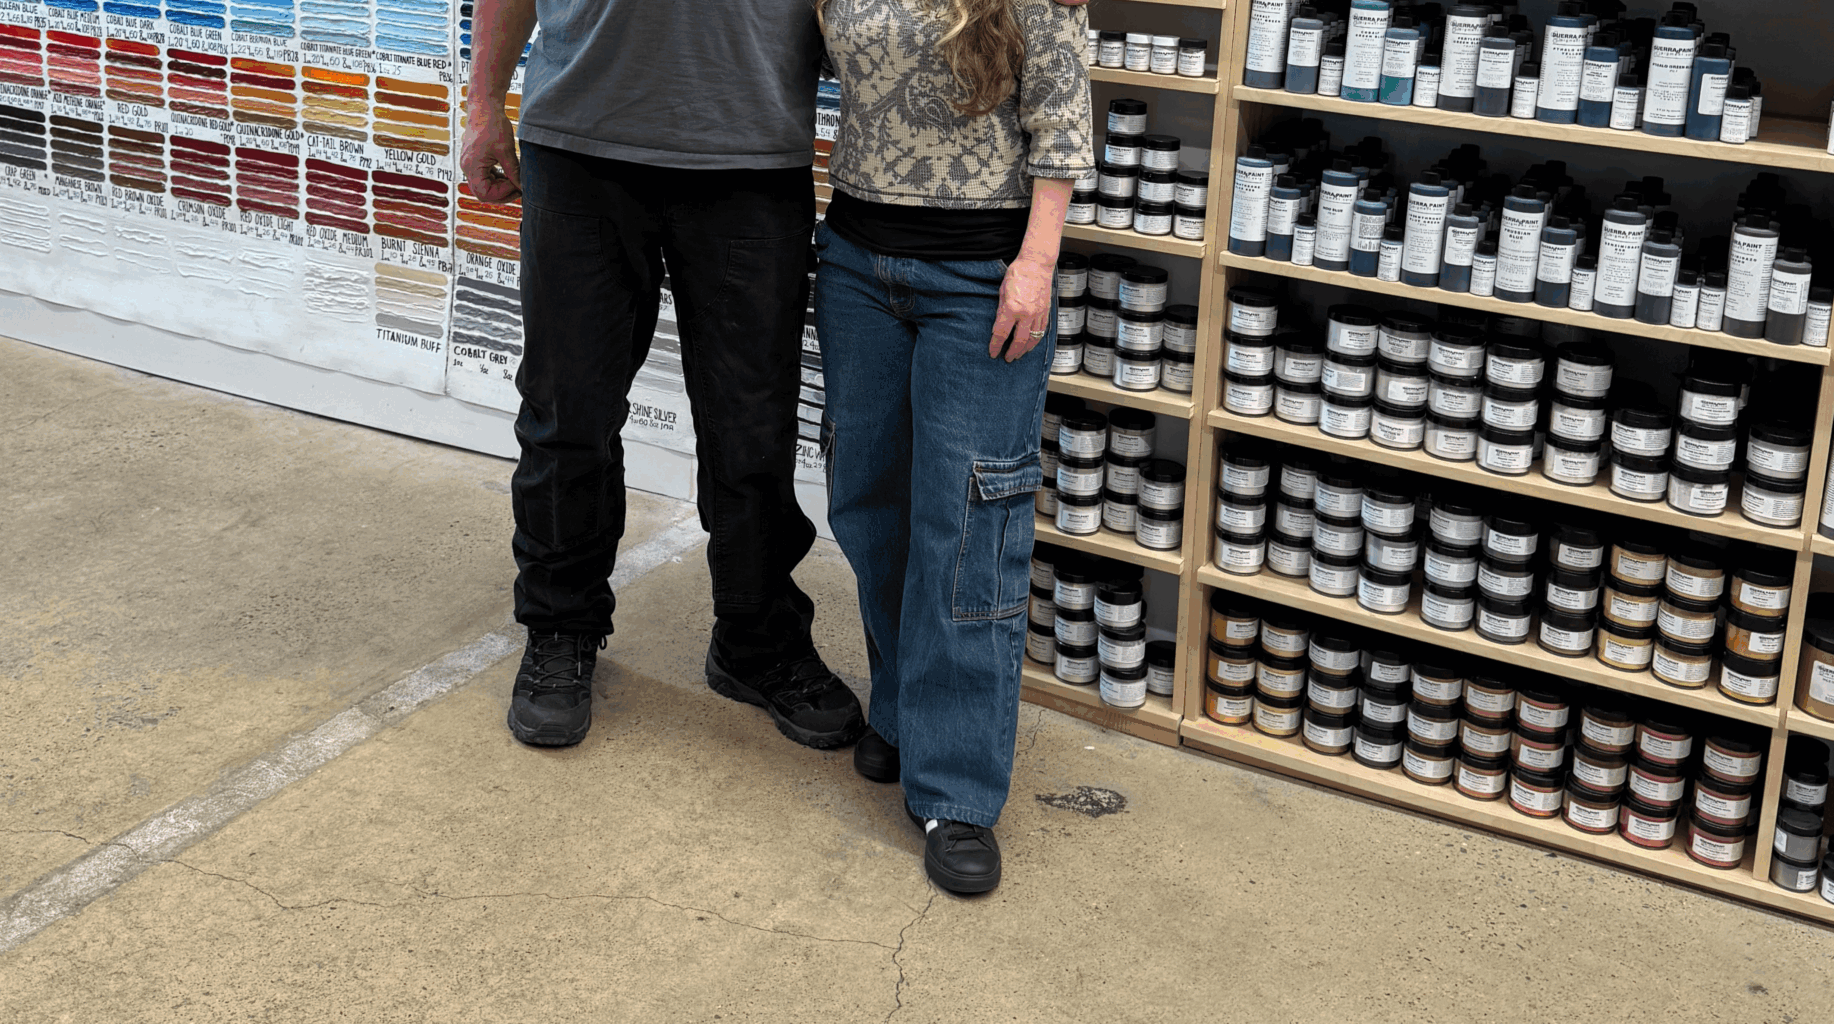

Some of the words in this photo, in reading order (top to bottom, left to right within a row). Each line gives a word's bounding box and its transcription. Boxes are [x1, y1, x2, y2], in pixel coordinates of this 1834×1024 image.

[417, 56, 431, 67] BLUE
[433, 59, 446, 69] RED
[117, 103, 130, 113] RED
[132, 106, 149, 117] GOLD
[339, 141, 364, 155] BROWN
[384, 149, 414, 162] YELLOW
[416, 151, 436, 166] GOLD
[178, 200, 206, 214] CRIMSON
[208, 205, 226, 219] OXIDE
[306, 225, 317, 237] RED
[319, 227, 337, 241] OXIDE
[342, 231, 369, 248] MEDIUM
[381, 238, 406, 253] BURNT
[412, 242, 440, 259] SIENNA
[466, 252, 492, 269] ORANGE
[497, 258, 516, 274] OXIDE
[377, 329, 418, 346] TITANIUM
[421, 337, 441, 353] BUFF
[454, 346, 486, 363] COBALT
[490, 352, 508, 365] GREY
[633, 403, 652, 417] SHINE
[653, 407, 677, 424] SILVER
[795, 444, 814, 459] ZINC
